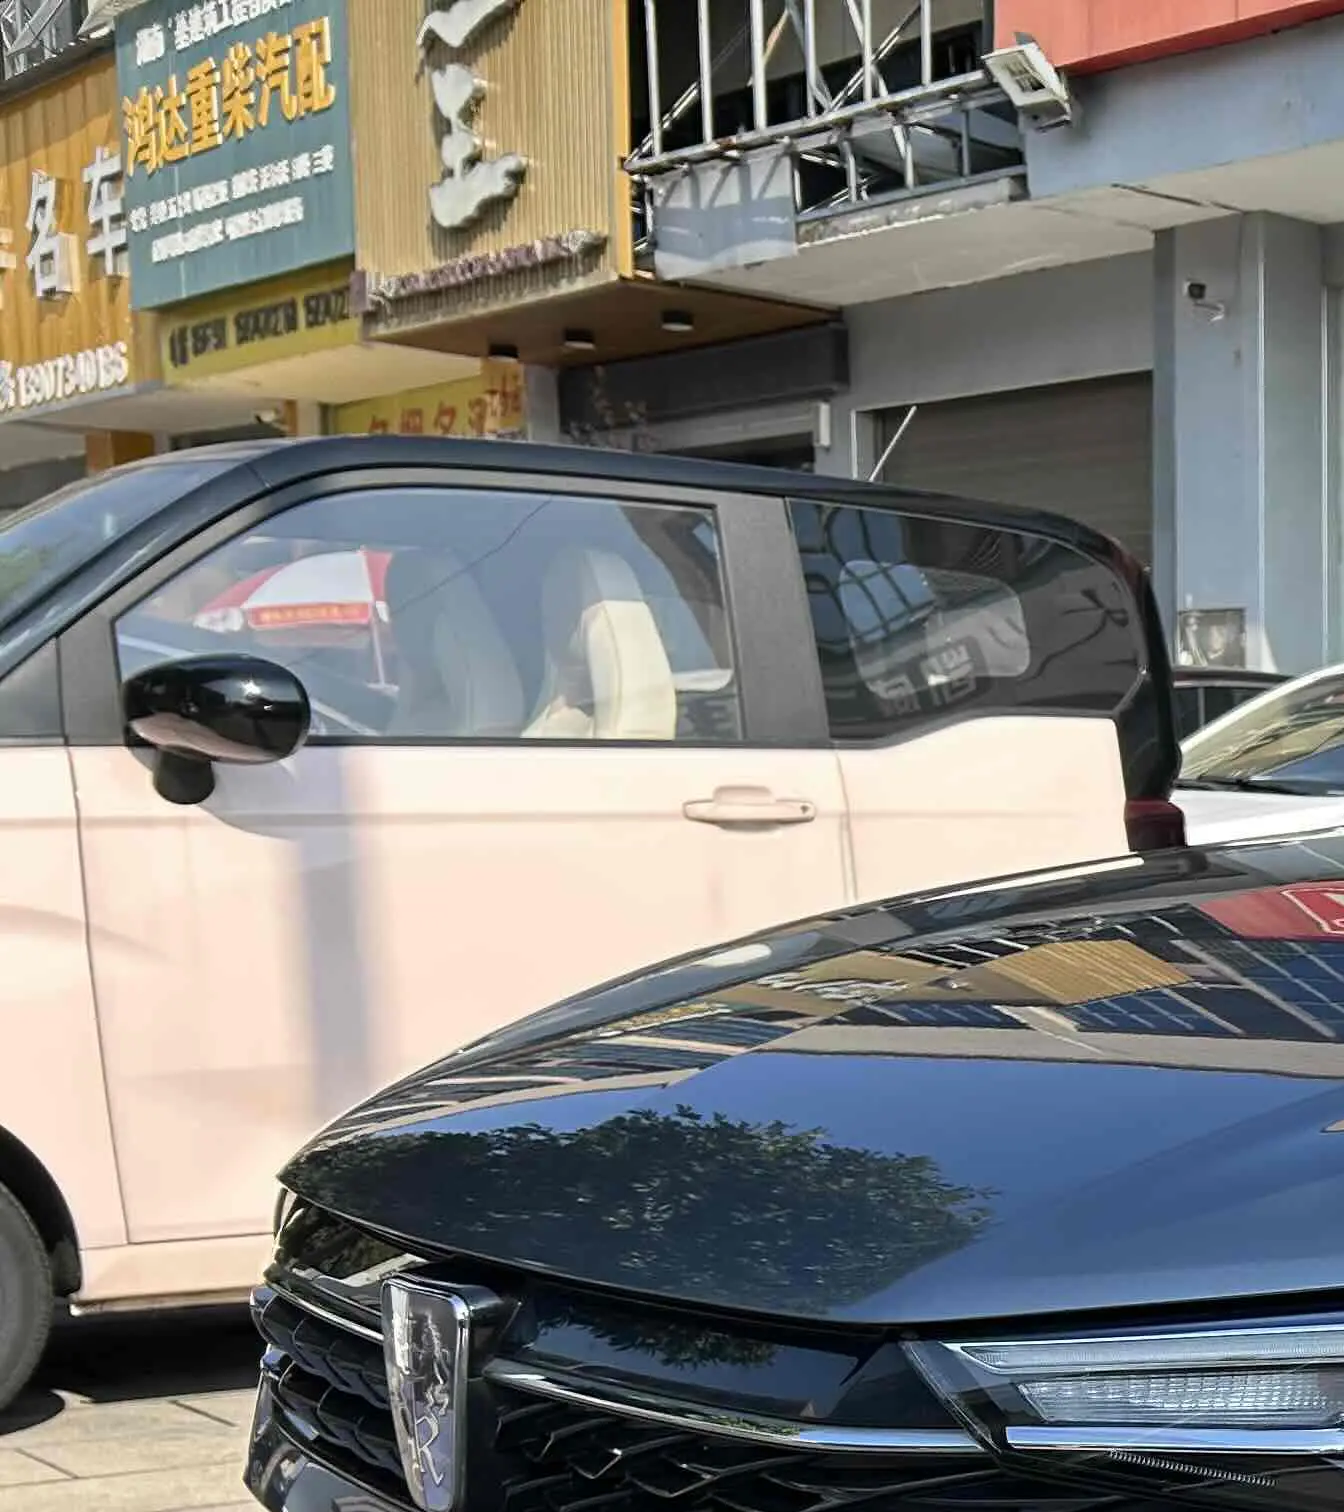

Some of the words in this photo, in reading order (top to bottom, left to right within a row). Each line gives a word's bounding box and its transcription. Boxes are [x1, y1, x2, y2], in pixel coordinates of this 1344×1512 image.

[122, 16, 336, 177] 鸿达重柴汽配
